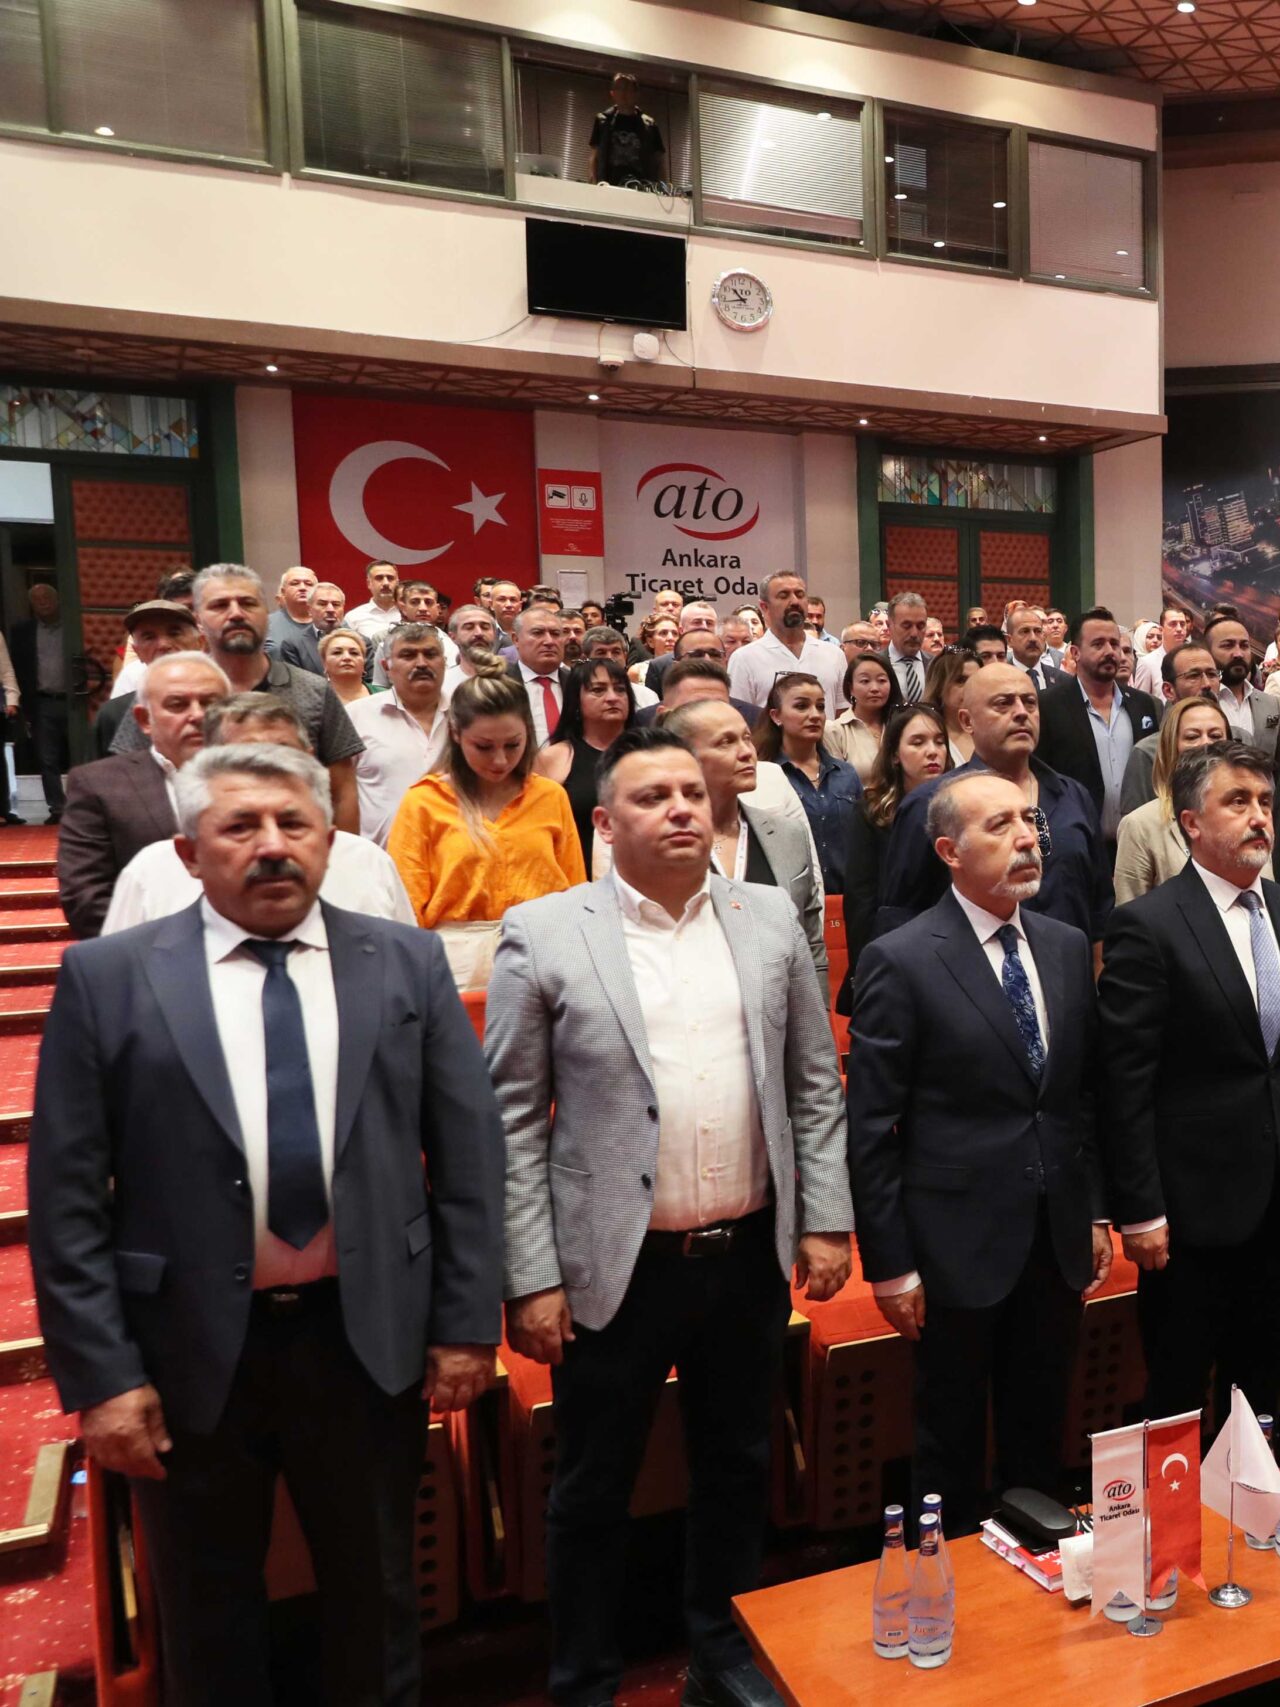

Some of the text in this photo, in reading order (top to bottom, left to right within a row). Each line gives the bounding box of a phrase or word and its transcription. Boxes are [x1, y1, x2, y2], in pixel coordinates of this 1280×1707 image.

[653, 477, 744, 521] ato
[661, 548, 741, 569] Ankara
[625, 573, 759, 596] Ticaret Oda
[830, 920, 841, 928] 16
[1107, 1483, 1132, 1498] ato
[1099, 1508, 1140, 1522] Ticaret Odası
[1109, 1502, 1131, 1513] Ankara
